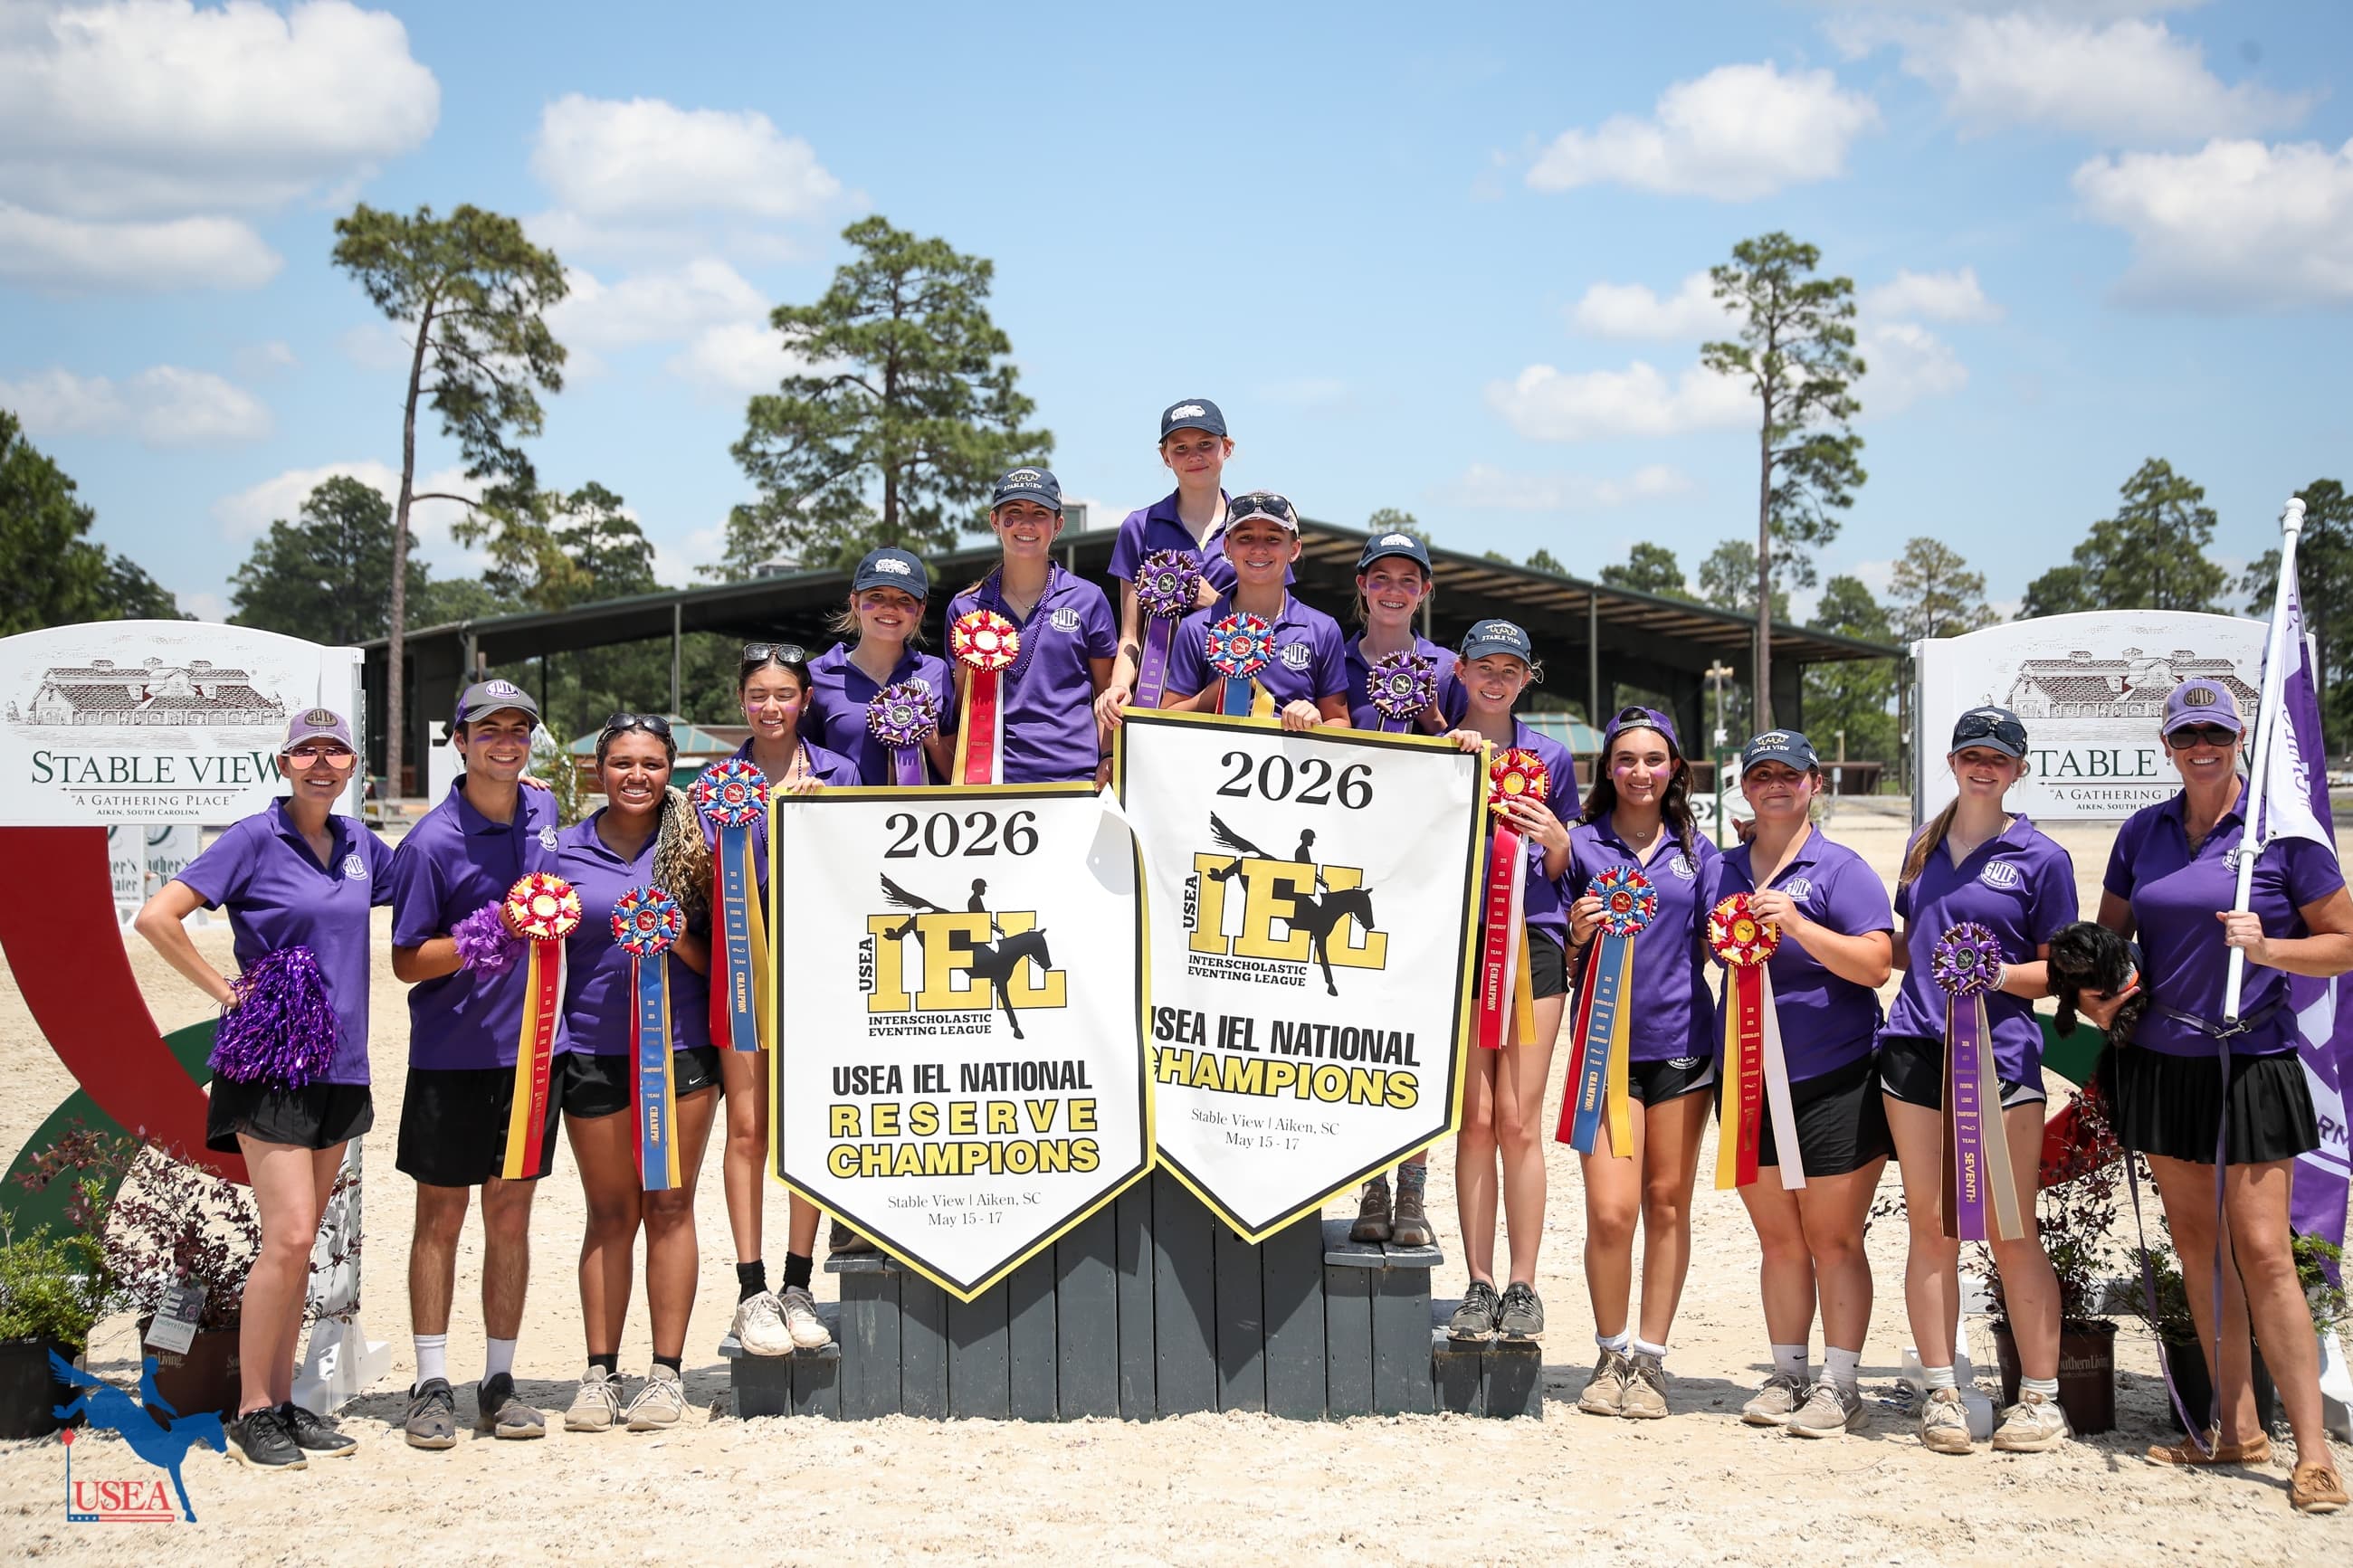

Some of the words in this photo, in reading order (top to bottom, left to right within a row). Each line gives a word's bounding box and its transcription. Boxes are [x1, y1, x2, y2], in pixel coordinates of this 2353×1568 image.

[32, 750, 176, 784] STABLE
[186, 751, 283, 784] VIEW
[2024, 749, 2158, 778] TABLE
[1216, 751, 1374, 810] 2026
[2071, 788, 2162, 801] GATHERING
[91, 794, 179, 806] GATHERING
[2076, 803, 2105, 812] AIKEN,
[2107, 803, 2138, 811] SOUTH
[883, 810, 1039, 859] 2026
[113, 859, 137, 874] er's
[114, 879, 138, 891] ater
[1183, 875, 1198, 929] USEA
[859, 937, 873, 993] USEA
[1187, 965, 1252, 983] EVENTING
[1254, 973, 1306, 987] LEAGUE
[1188, 954, 1308, 975] INTERSCHOLASTIC
[736, 972, 748, 1014] CHAMPION
[868, 1013, 993, 1026] INTERSCHOLASTIC
[868, 1025, 938, 1037] EVENTING
[939, 1024, 993, 1035] LEAGUE
[1151, 1005, 1206, 1047] SEA
[1217, 1014, 1260, 1052] IEL
[1270, 1020, 1421, 1067] NATIONAL
[833, 1065, 903, 1096] USEA
[913, 1063, 951, 1094] IEL
[960, 1060, 1093, 1092] NATIONAL
[1151, 1045, 1420, 1110] HAMPIONS
[829, 1098, 1098, 1138] RESERVE
[1191, 1107, 1228, 1126] Stable
[1232, 1113, 1264, 1129] View
[1275, 1117, 1317, 1135] Aiken,
[1320, 1122, 1339, 1136] SC
[1224, 1131, 1254, 1149] May
[1259, 1136, 1273, 1148] 15
[1285, 1138, 1300, 1151] 17
[827, 1137, 1100, 1179] CHAMPIONS
[1964, 1152, 1977, 1203] SEVENTH
[888, 1194, 929, 1209] Stable
[932, 1193, 966, 1207] View
[976, 1193, 1019, 1208] Aiken,
[1023, 1192, 1042, 1205] SC
[928, 1212, 957, 1228] May
[962, 1212, 976, 1225] 15
[988, 1212, 1003, 1224] 17
